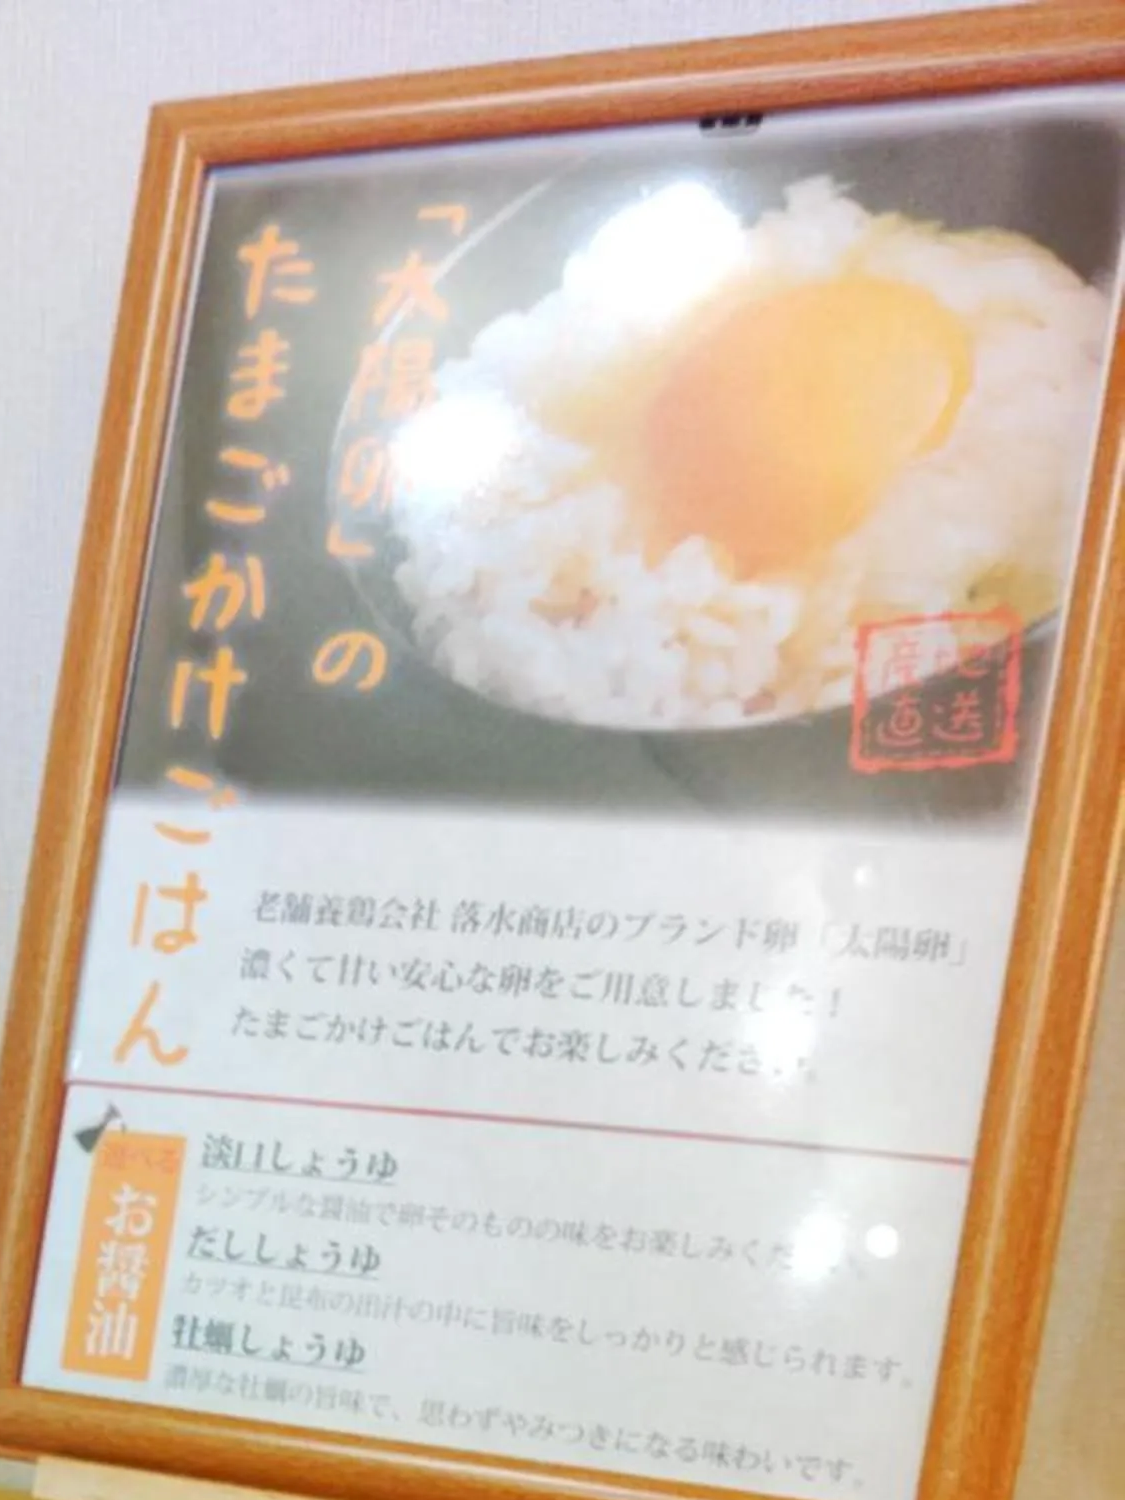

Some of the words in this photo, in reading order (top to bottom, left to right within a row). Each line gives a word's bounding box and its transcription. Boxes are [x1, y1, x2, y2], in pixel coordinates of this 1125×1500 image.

[113, 224, 316, 1066] たまごかけごはん
[231, 1006, 817, 1084] たまごかけごはんでお楽しみくださ。
[201, 1133, 399, 1181] 淡口しょうゆ
[85, 1181, 158, 1361] お醤油
[187, 1225, 382, 1274] だししょうゆ
[172, 1314, 367, 1366] 牡蠣しょうゆ
